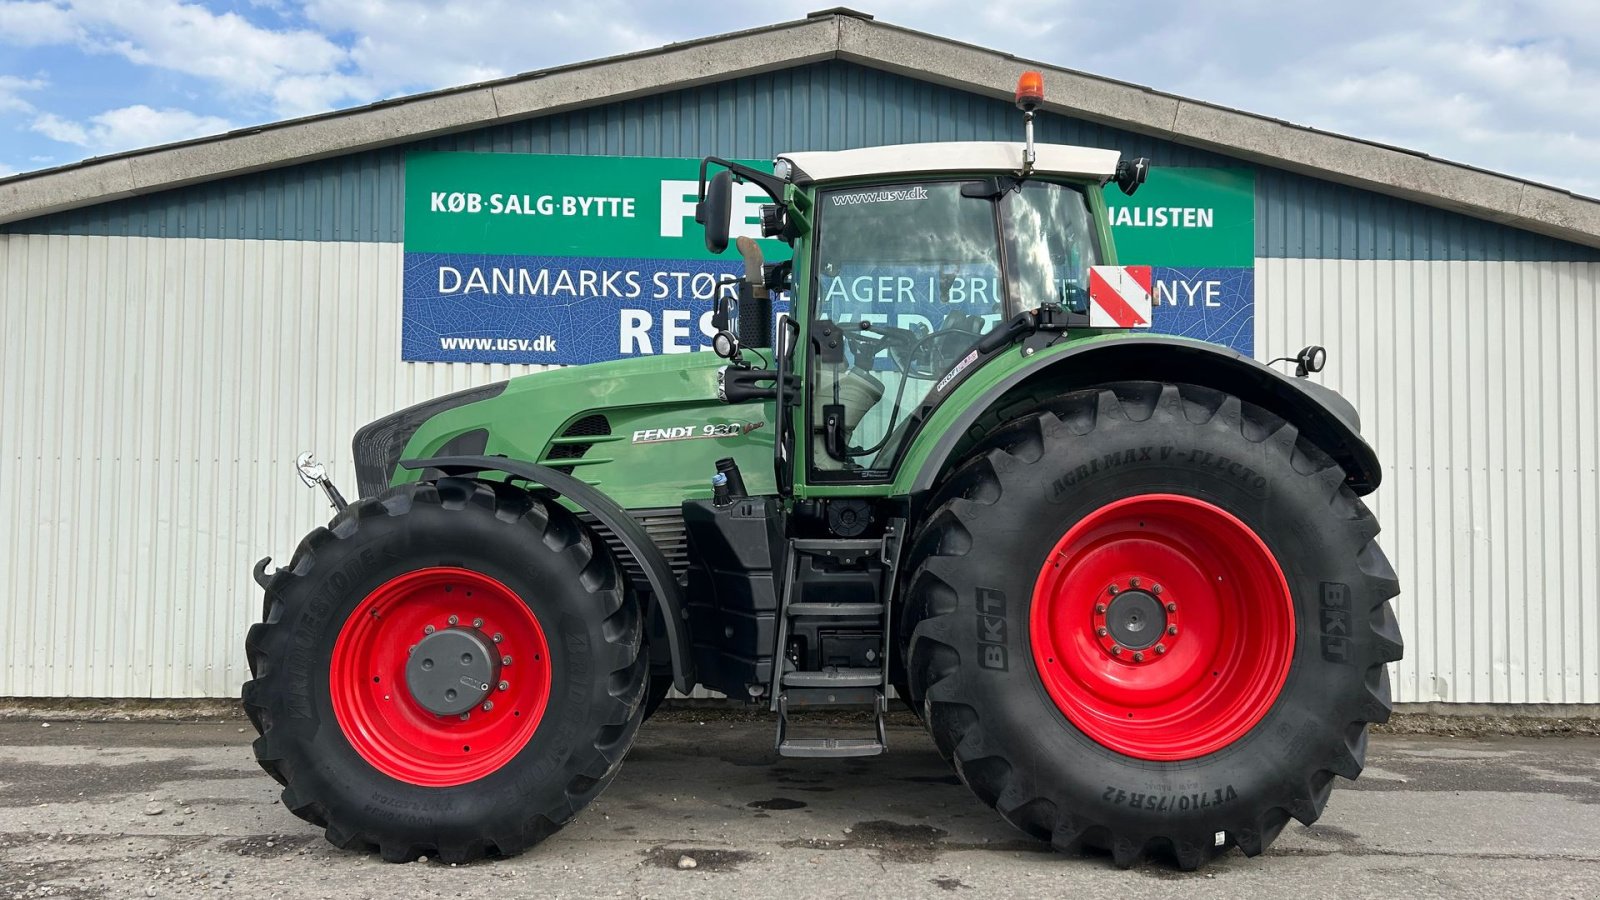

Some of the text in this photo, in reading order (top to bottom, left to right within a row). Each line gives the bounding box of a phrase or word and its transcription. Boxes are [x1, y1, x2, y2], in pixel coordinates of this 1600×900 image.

[832, 186, 928, 206] www.usv.dk
[439, 266, 641, 298] DANMARKS
[1158, 280, 1221, 307] NYE
[440, 336, 557, 352] www.usv.dk
[632, 425, 697, 441] FENDT
[703, 422, 741, 436] 930
[978, 588, 1007, 671] BKT
[1322, 582, 1349, 662] BKT
